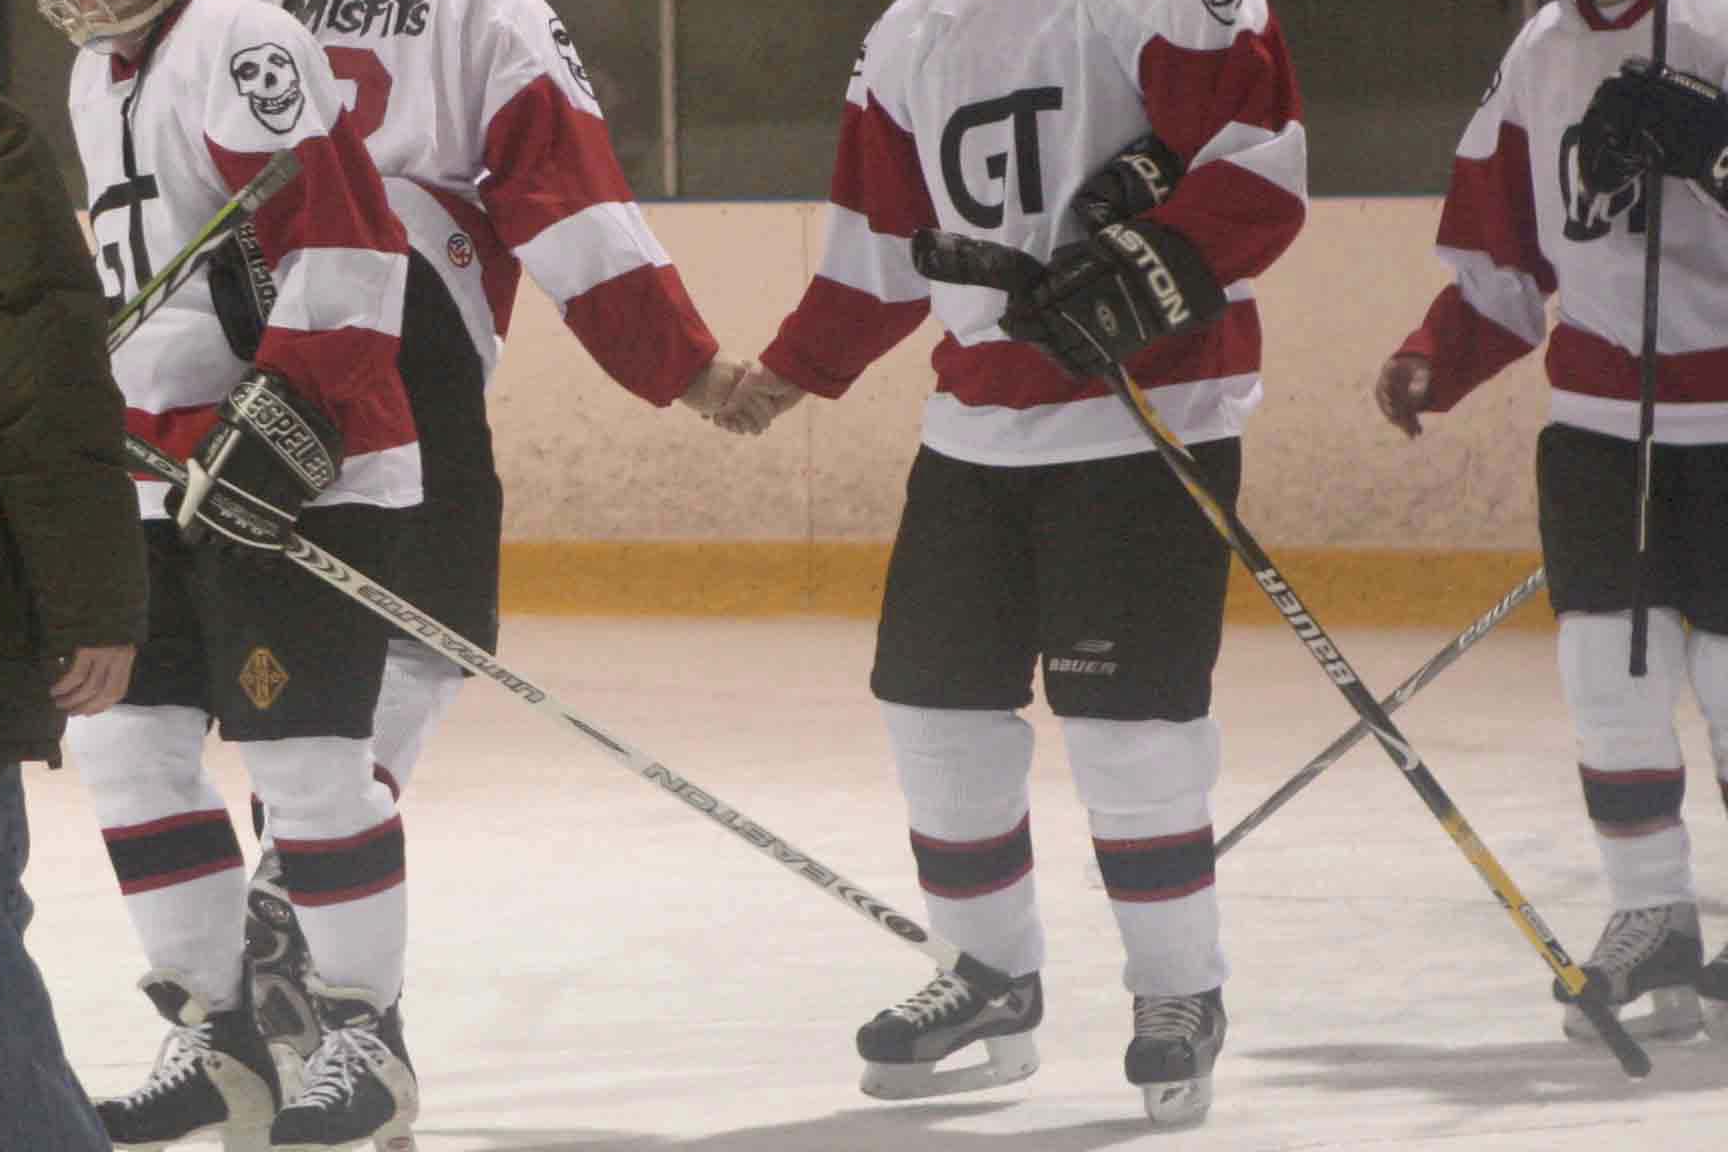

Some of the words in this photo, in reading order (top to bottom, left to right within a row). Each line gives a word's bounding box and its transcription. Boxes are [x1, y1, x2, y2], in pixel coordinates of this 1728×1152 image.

[940, 86, 1063, 229] GT
[1099, 223, 1191, 326] ASTON
[1048, 658, 1119, 676] BAUER
[642, 762, 839, 889] EASTON
